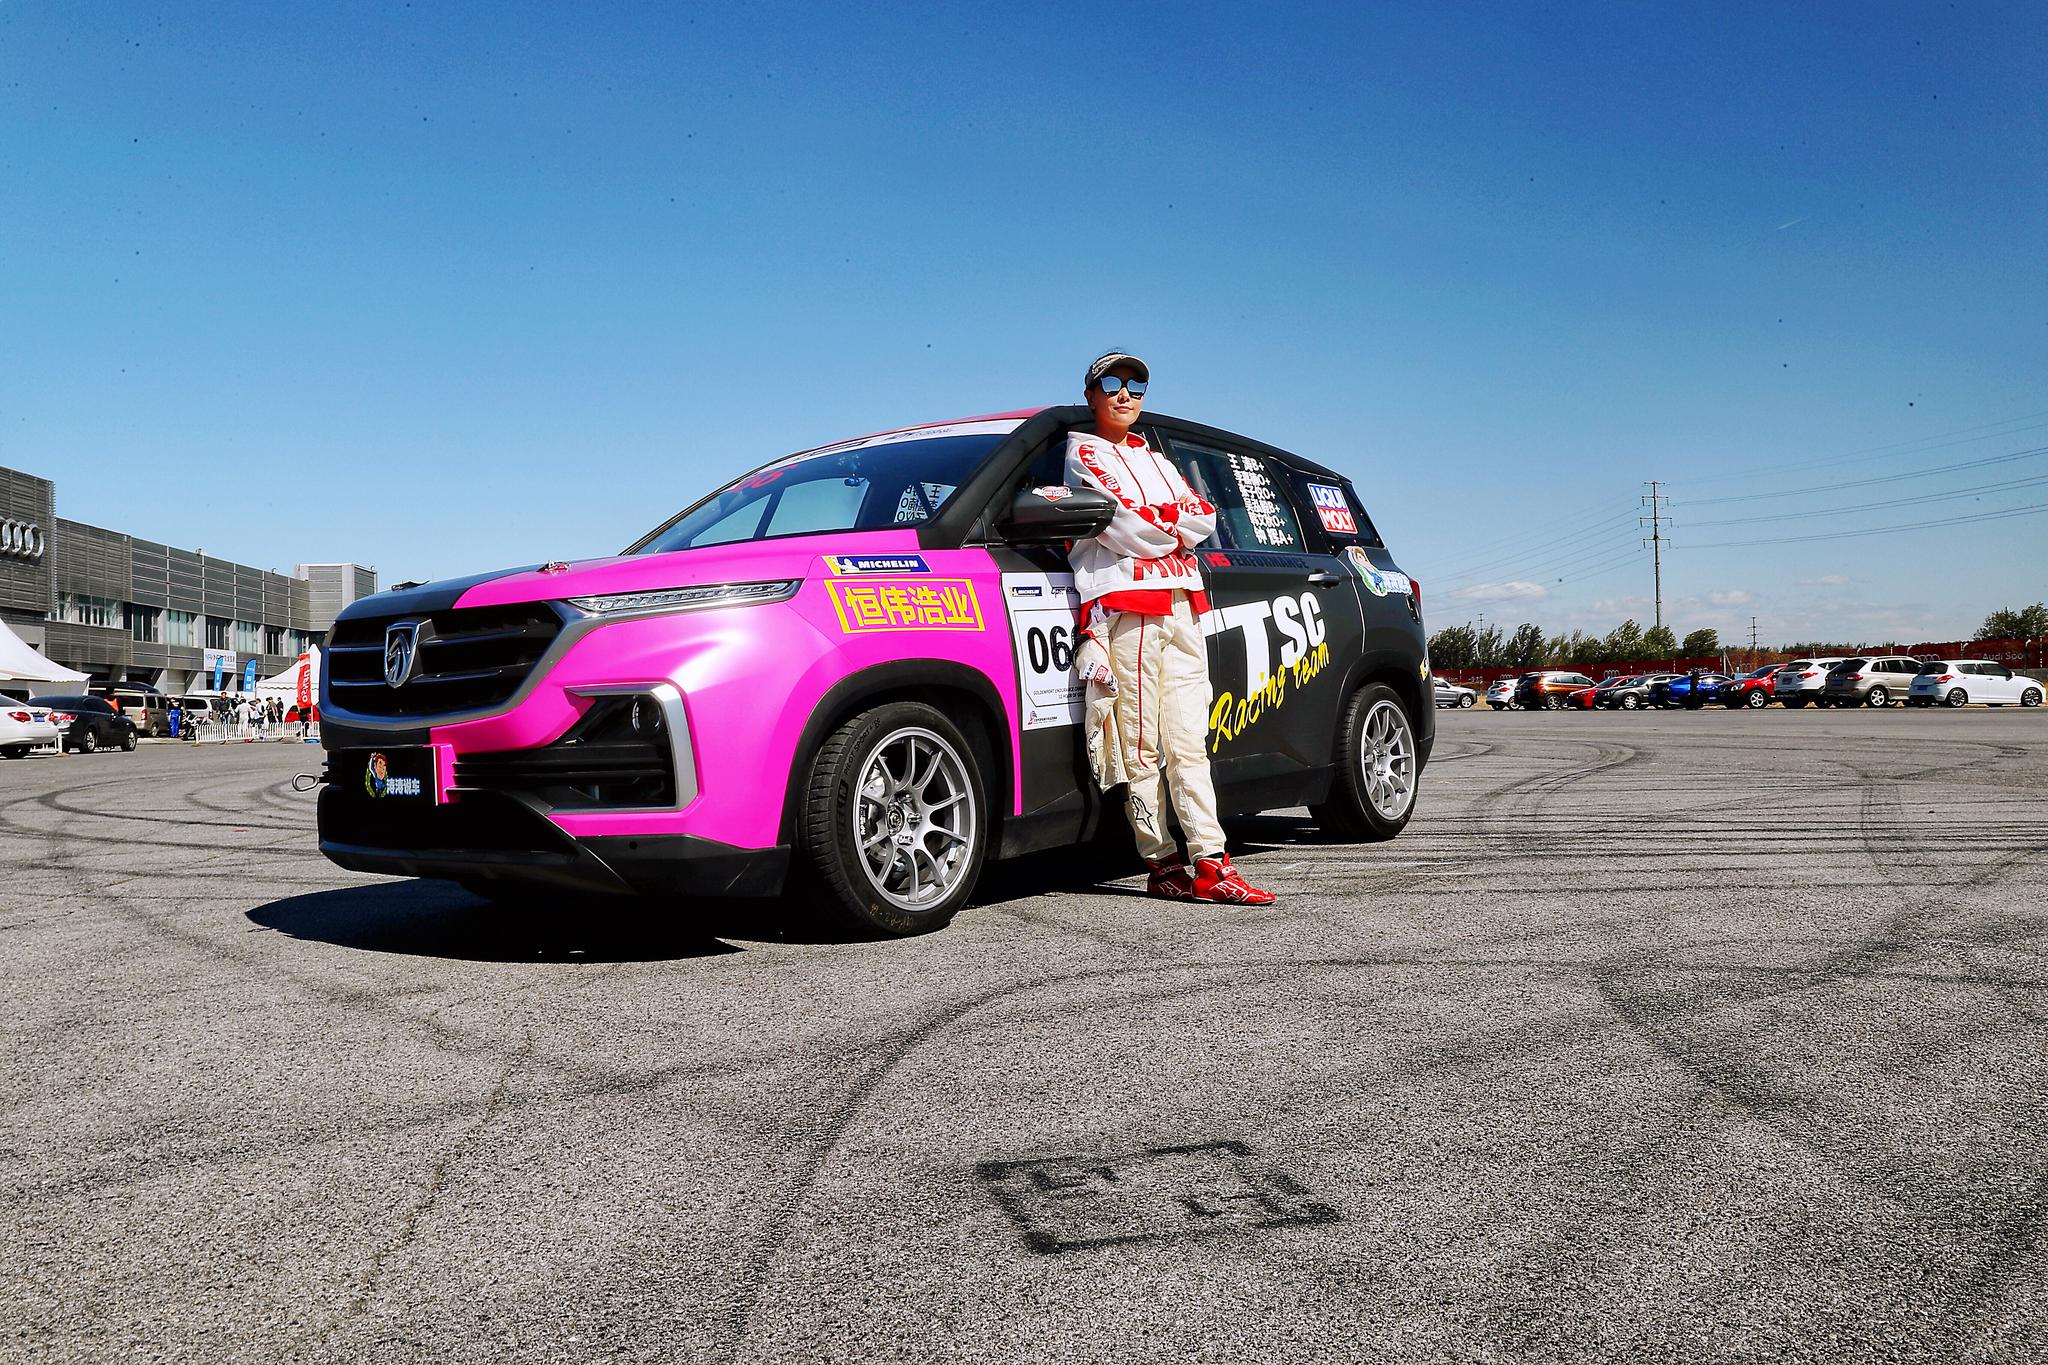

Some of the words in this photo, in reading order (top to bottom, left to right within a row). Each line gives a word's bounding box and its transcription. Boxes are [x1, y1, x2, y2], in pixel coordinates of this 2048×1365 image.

[1310, 486, 1347, 508] LIQUI
[1320, 509, 1354, 531] MOLY
[857, 559, 919, 569] MICHELIN
[843, 585, 975, 627] 恒伟浩业
[1027, 625, 1080, 674] 06
[1209, 664, 1287, 753] Racing
[1293, 641, 1330, 690] team
